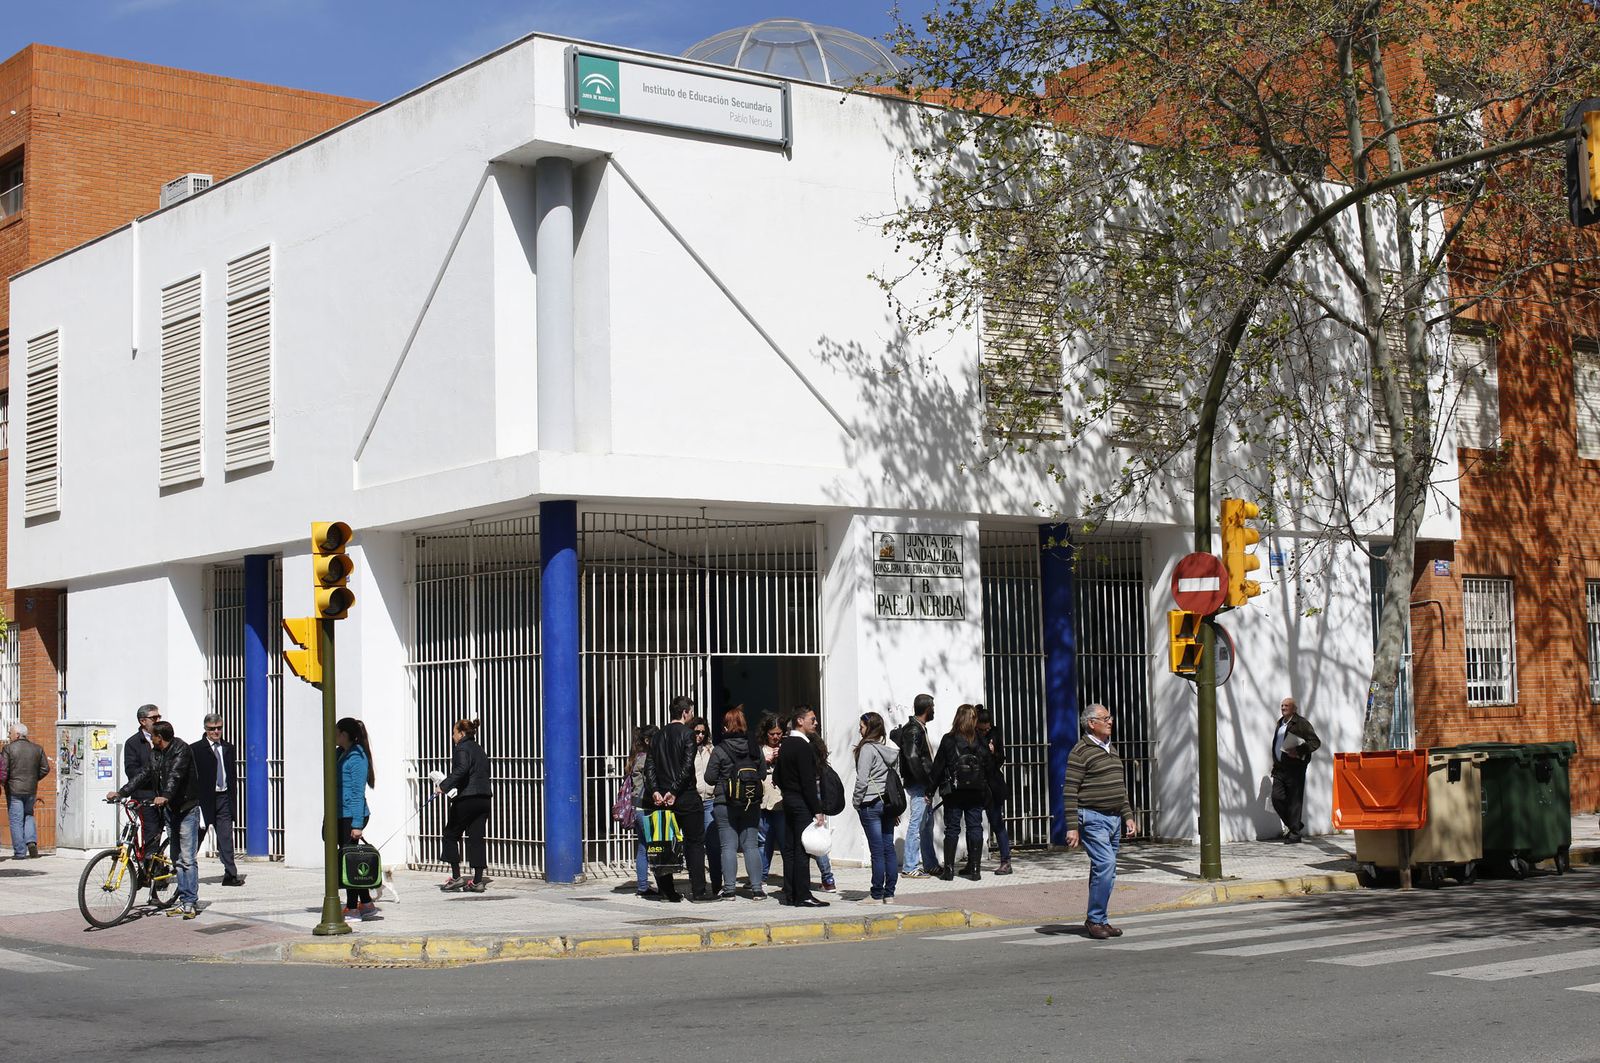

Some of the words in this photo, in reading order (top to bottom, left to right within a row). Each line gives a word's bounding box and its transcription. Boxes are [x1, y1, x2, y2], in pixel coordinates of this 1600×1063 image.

[642, 82, 676, 97] Instituto
[677, 88, 687, 99] de
[689, 90, 729, 106] Educación
[731, 97, 772, 113] Secundaria
[729, 111, 748, 125] Pablo
[749, 114, 773, 128] Neruda
[906, 536, 938, 548] JUNTA
[942, 536, 953, 548] DE
[920, 595, 963, 617] NERUDA
